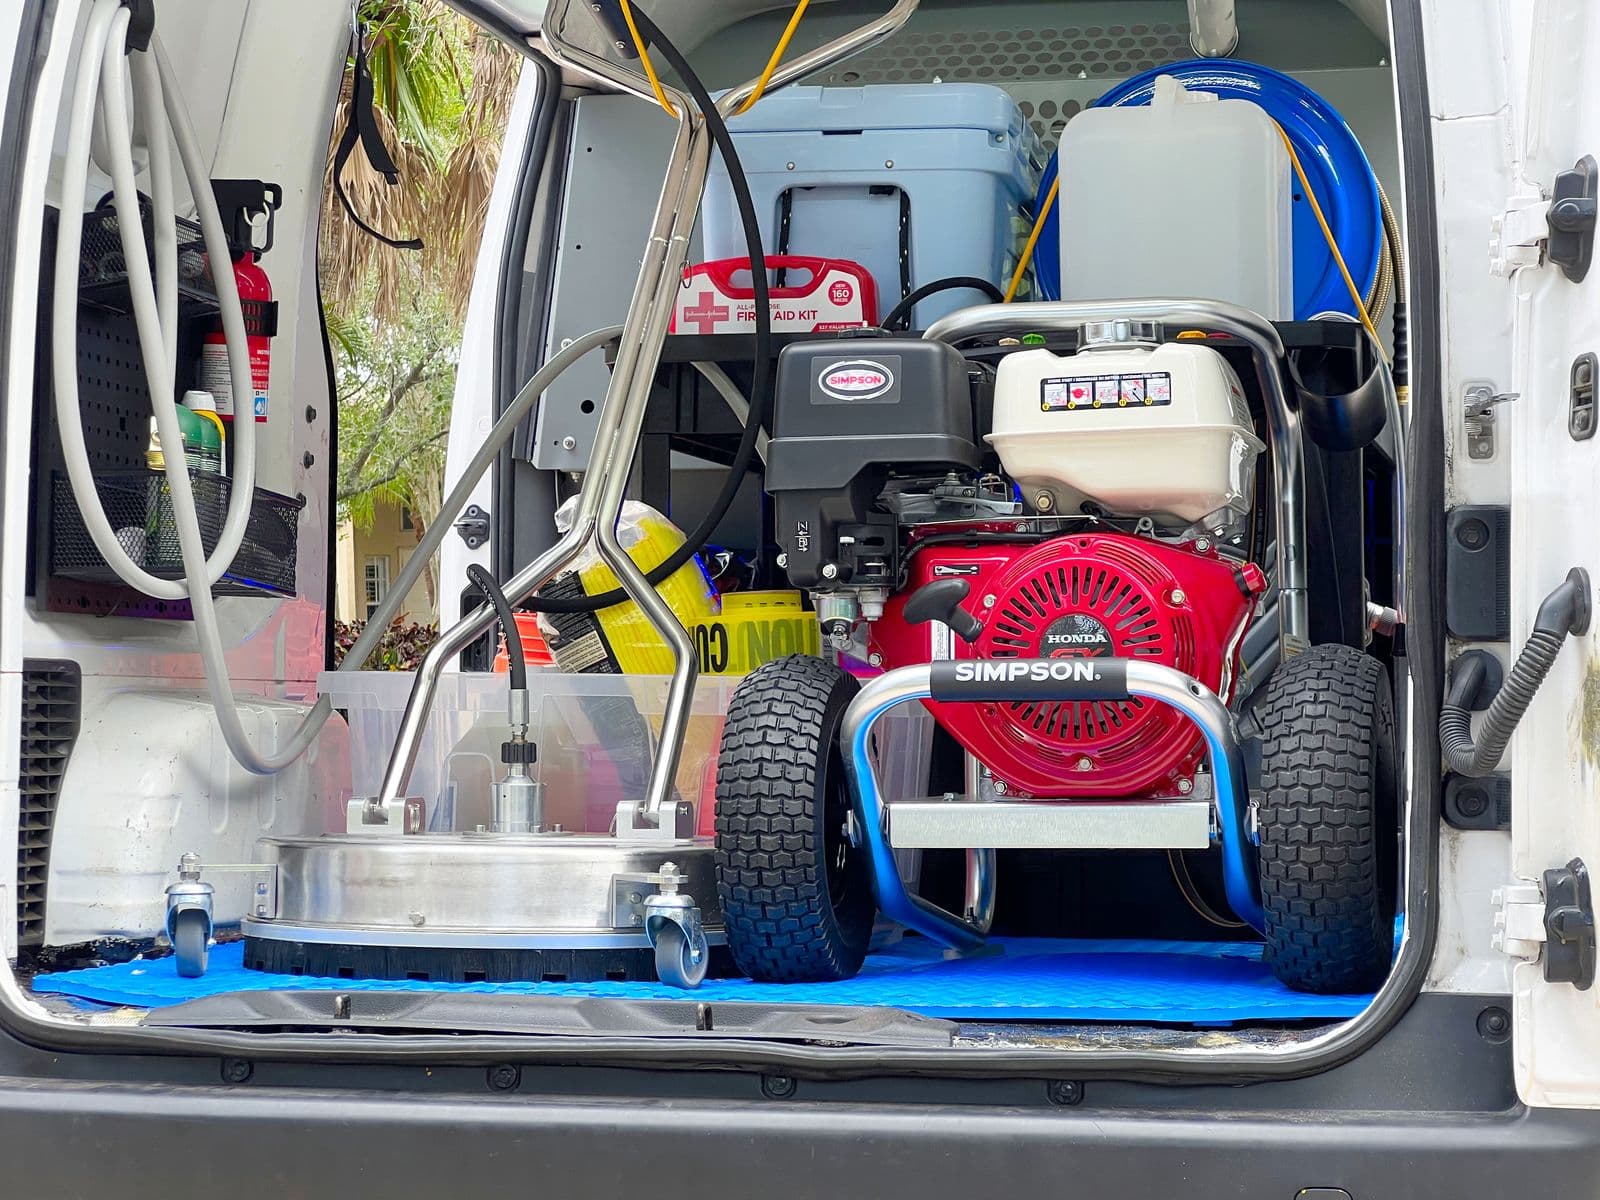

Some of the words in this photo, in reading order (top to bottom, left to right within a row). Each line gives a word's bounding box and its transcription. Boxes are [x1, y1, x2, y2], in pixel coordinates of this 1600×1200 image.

[832, 289, 850, 298] 160
[774, 310, 795, 321] AID
[798, 310, 818, 320] KIT
[830, 375, 882, 385] SIMPSON
[1047, 633, 1108, 644] HONDA
